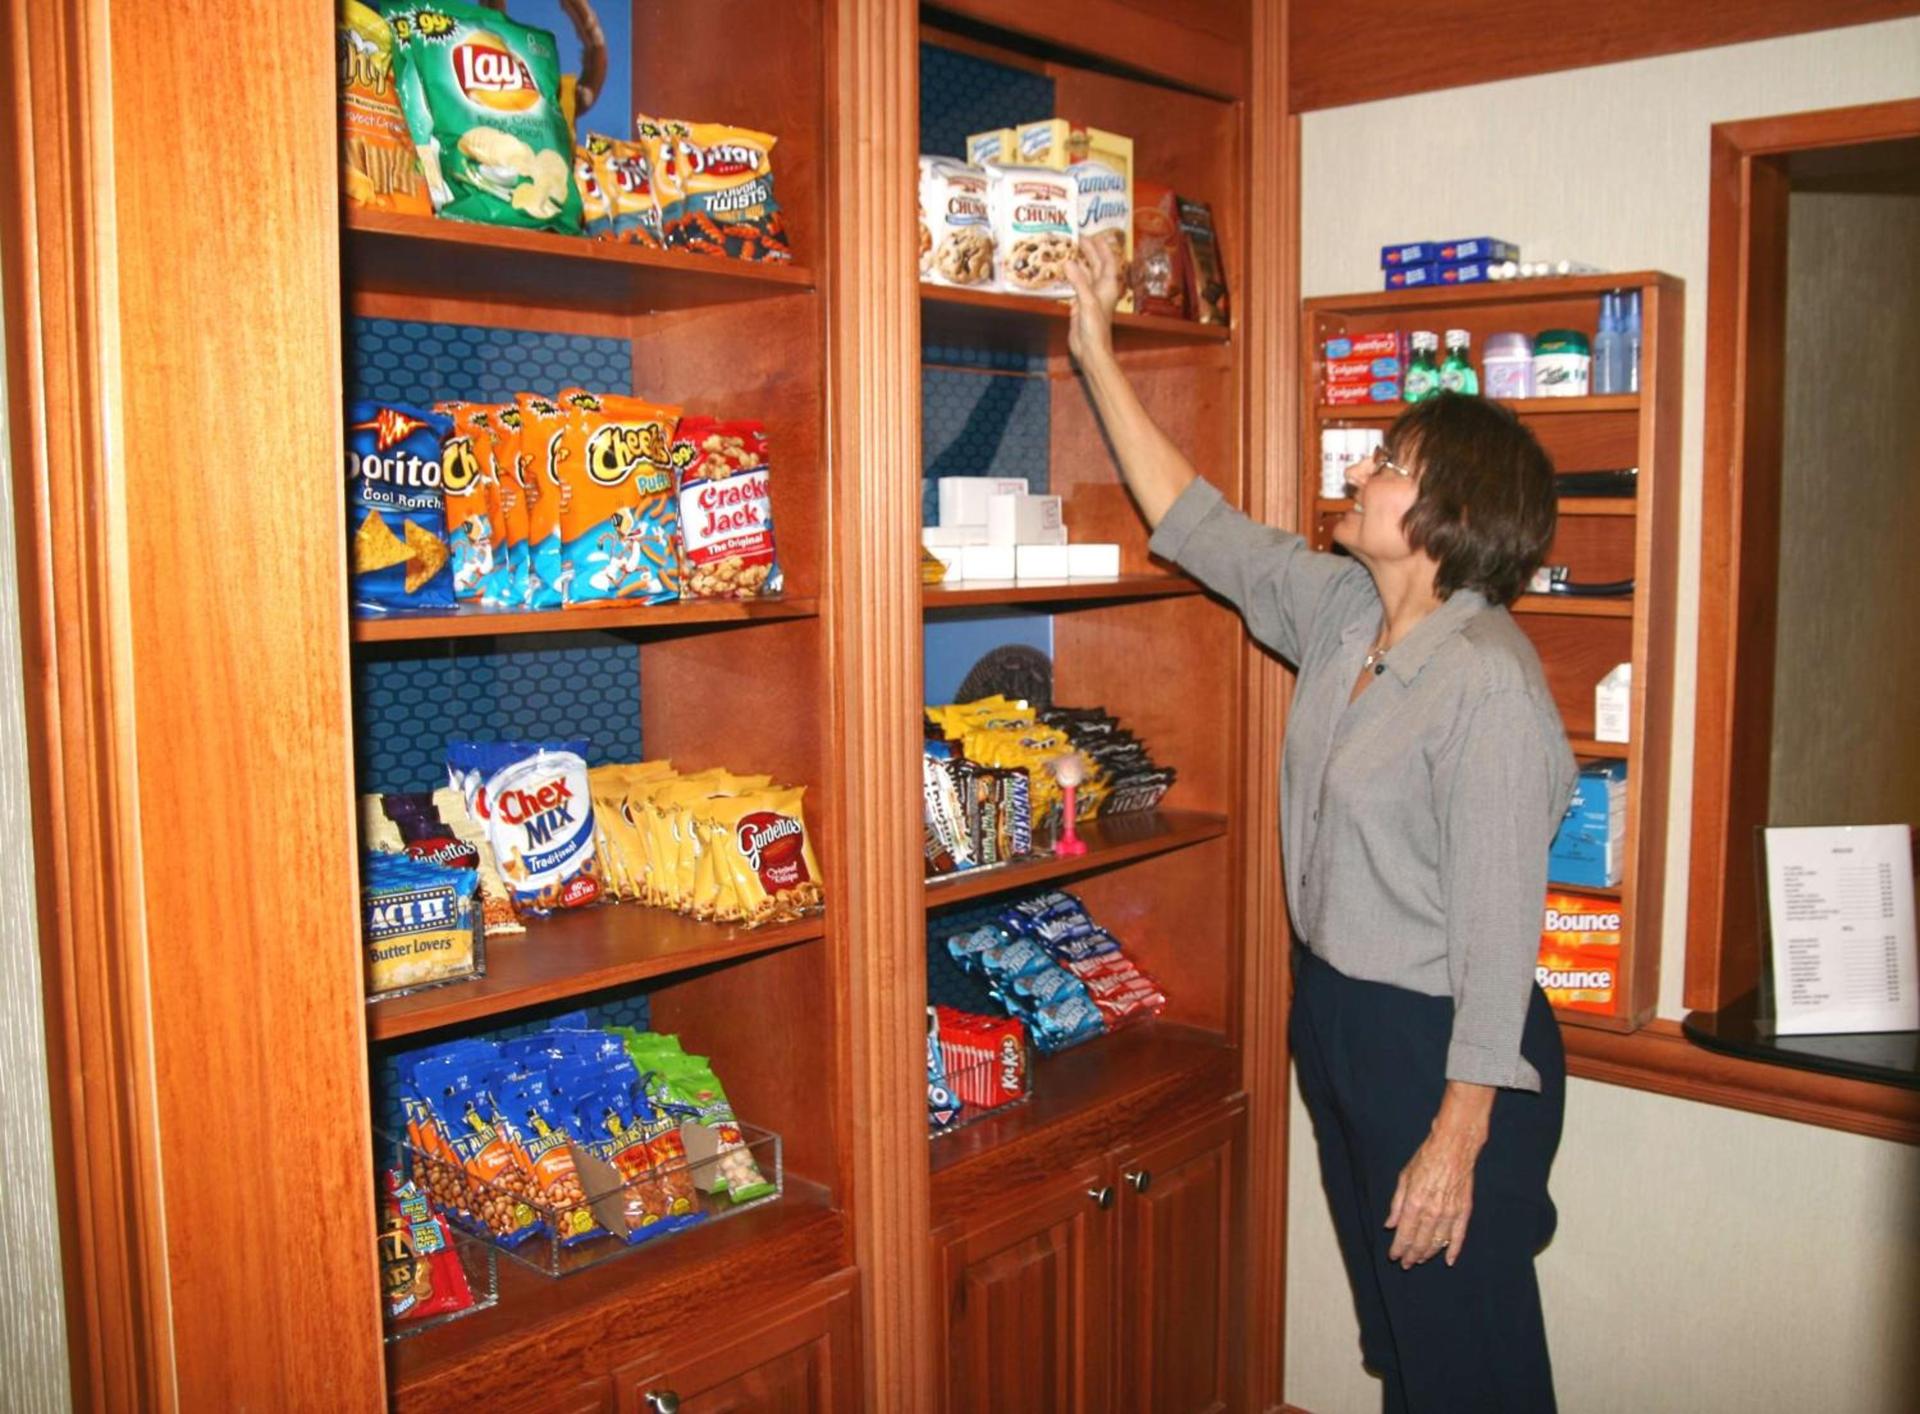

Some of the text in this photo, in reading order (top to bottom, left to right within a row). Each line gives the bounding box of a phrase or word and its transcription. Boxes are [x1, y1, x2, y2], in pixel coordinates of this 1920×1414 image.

[703, 185, 768, 214] TWISTS
[1079, 195, 1128, 228] Amos
[1015, 205, 1069, 226] CHUNK
[362, 487, 441, 510] Cool Ranch
[698, 477, 769, 511] Cracke
[700, 503, 758, 538] Jack
[498, 776, 574, 825] Chex
[529, 840, 578, 873] Traditional
[1545, 909, 1621, 932] Bounce
[413, 937, 453, 954] Lovers
[1536, 966, 1612, 989] Bounce
